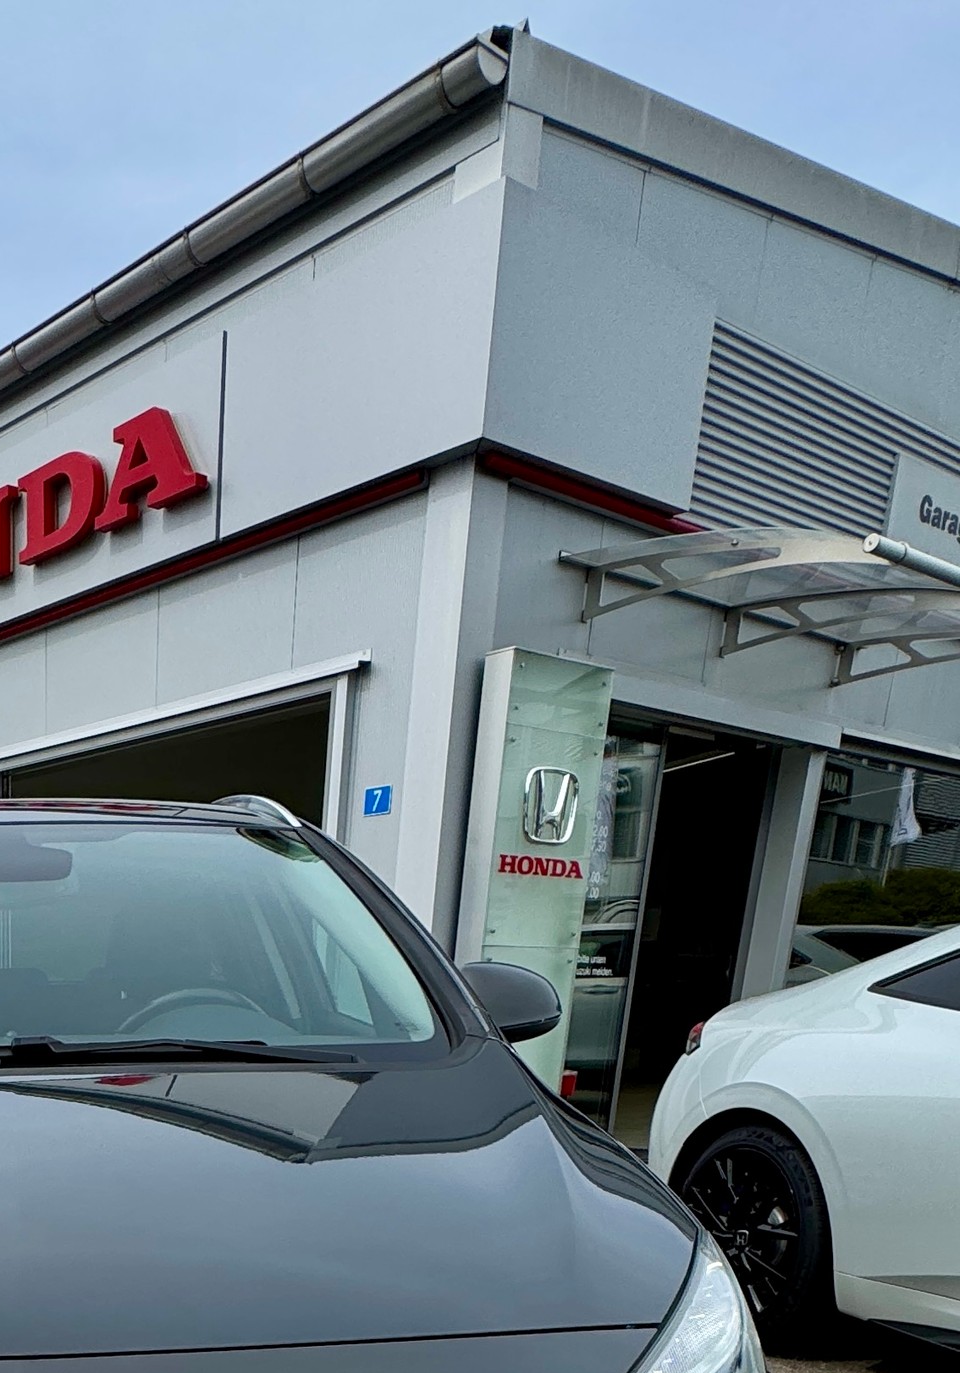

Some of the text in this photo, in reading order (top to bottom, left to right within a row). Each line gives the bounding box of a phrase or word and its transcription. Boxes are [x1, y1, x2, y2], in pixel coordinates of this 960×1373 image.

[920, 494, 960, 545] Gara
[373, 789, 382, 812] 7
[498, 854, 583, 879] HONDA
[575, 966, 591, 976] uzuki
